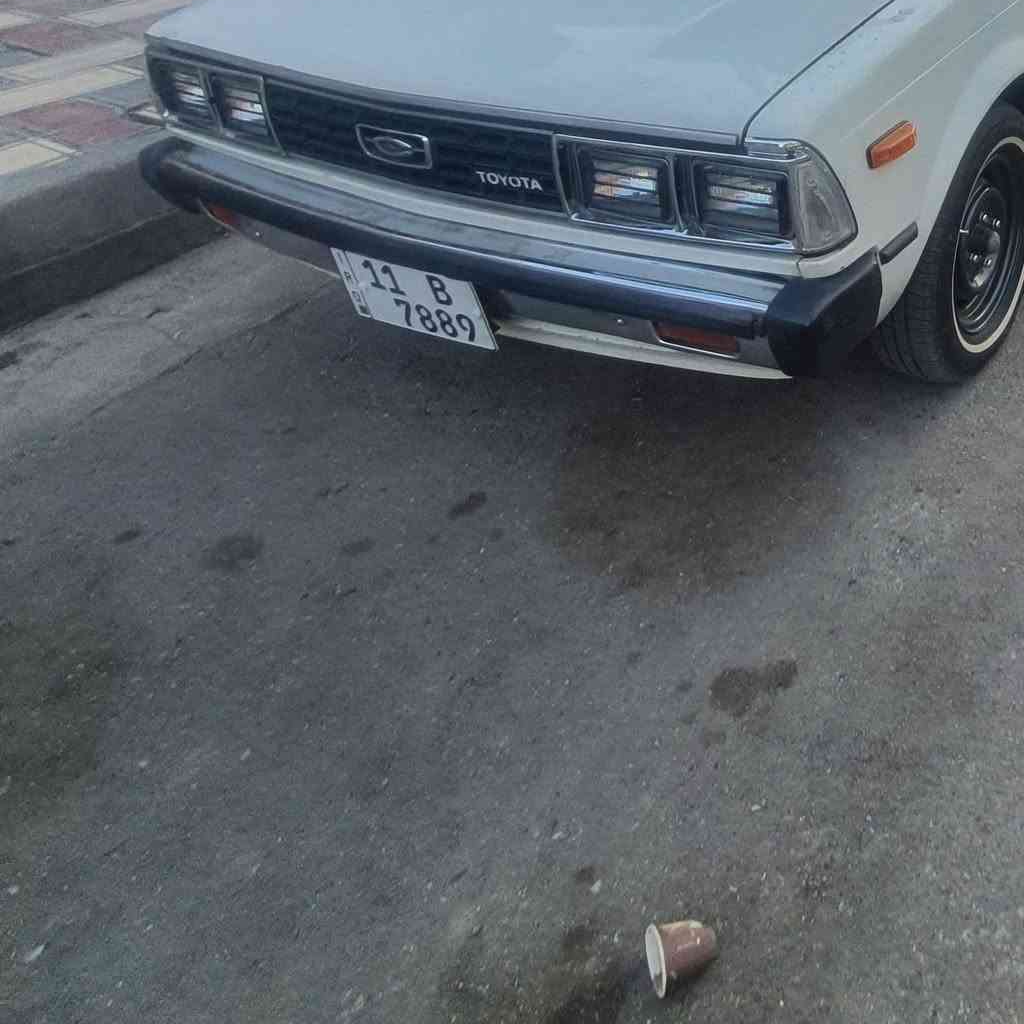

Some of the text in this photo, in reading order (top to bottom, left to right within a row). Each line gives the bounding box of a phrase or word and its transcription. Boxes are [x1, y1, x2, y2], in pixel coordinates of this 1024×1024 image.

[475, 170, 543, 192] TOYOTA
[361, 259, 453, 306] 11 B
[393, 298, 476, 342] 7889
